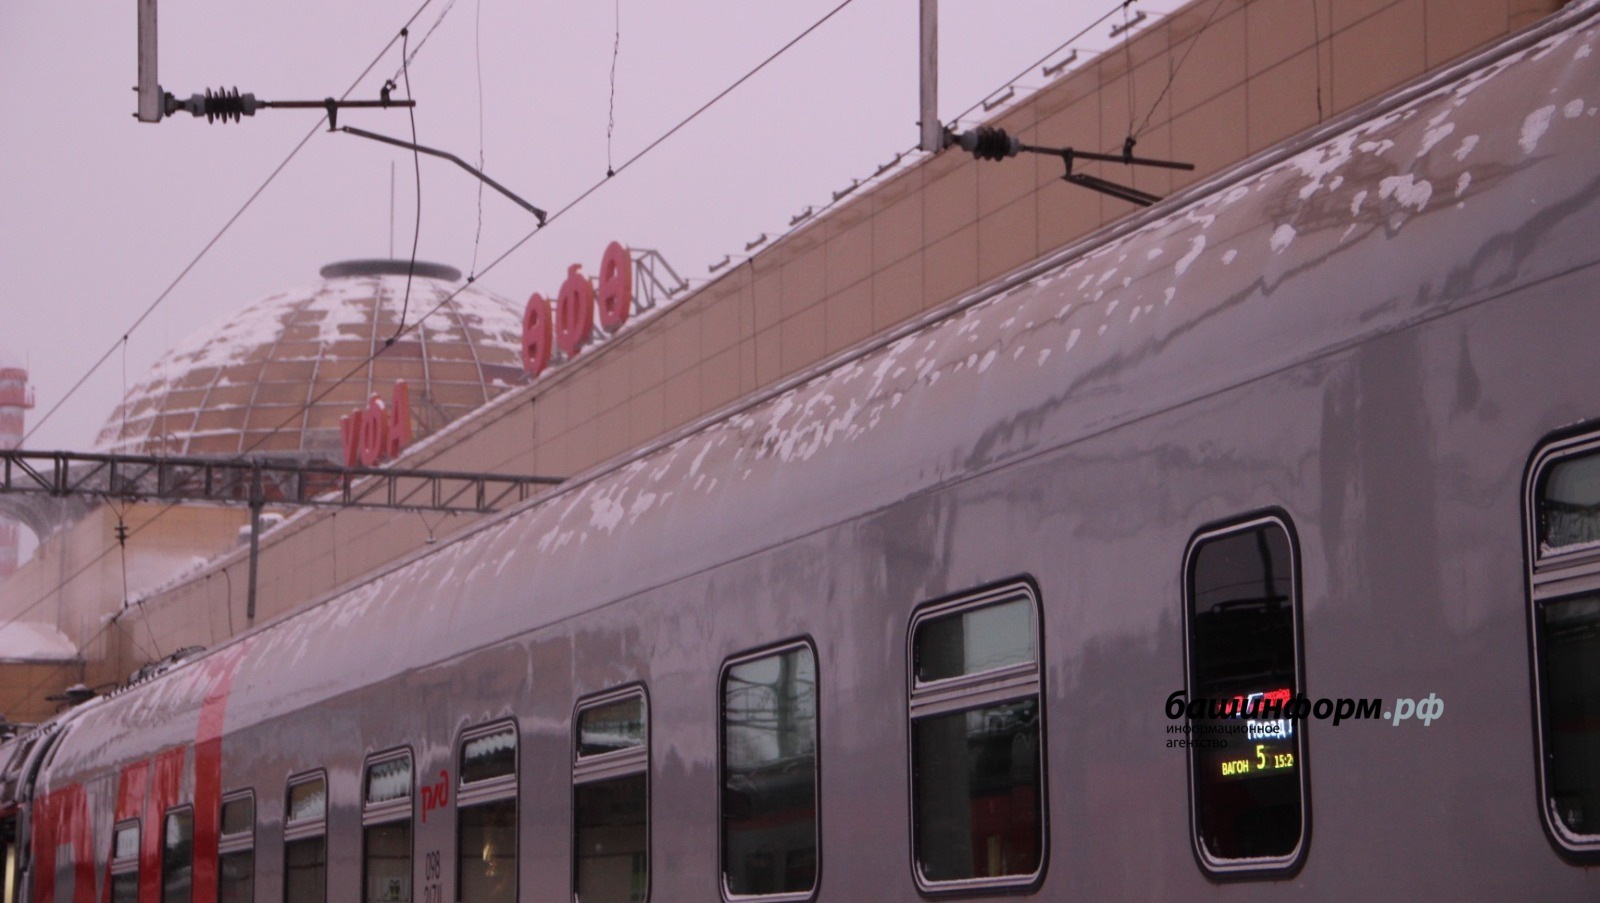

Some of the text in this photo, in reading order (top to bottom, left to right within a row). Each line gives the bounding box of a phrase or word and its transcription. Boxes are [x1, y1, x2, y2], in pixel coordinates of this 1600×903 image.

[340, 379, 411, 478] УФА
[1222, 759, 1249, 775] ВАГОН
[1256, 745, 1266, 769] 5
[426, 850, 440, 880] 098
